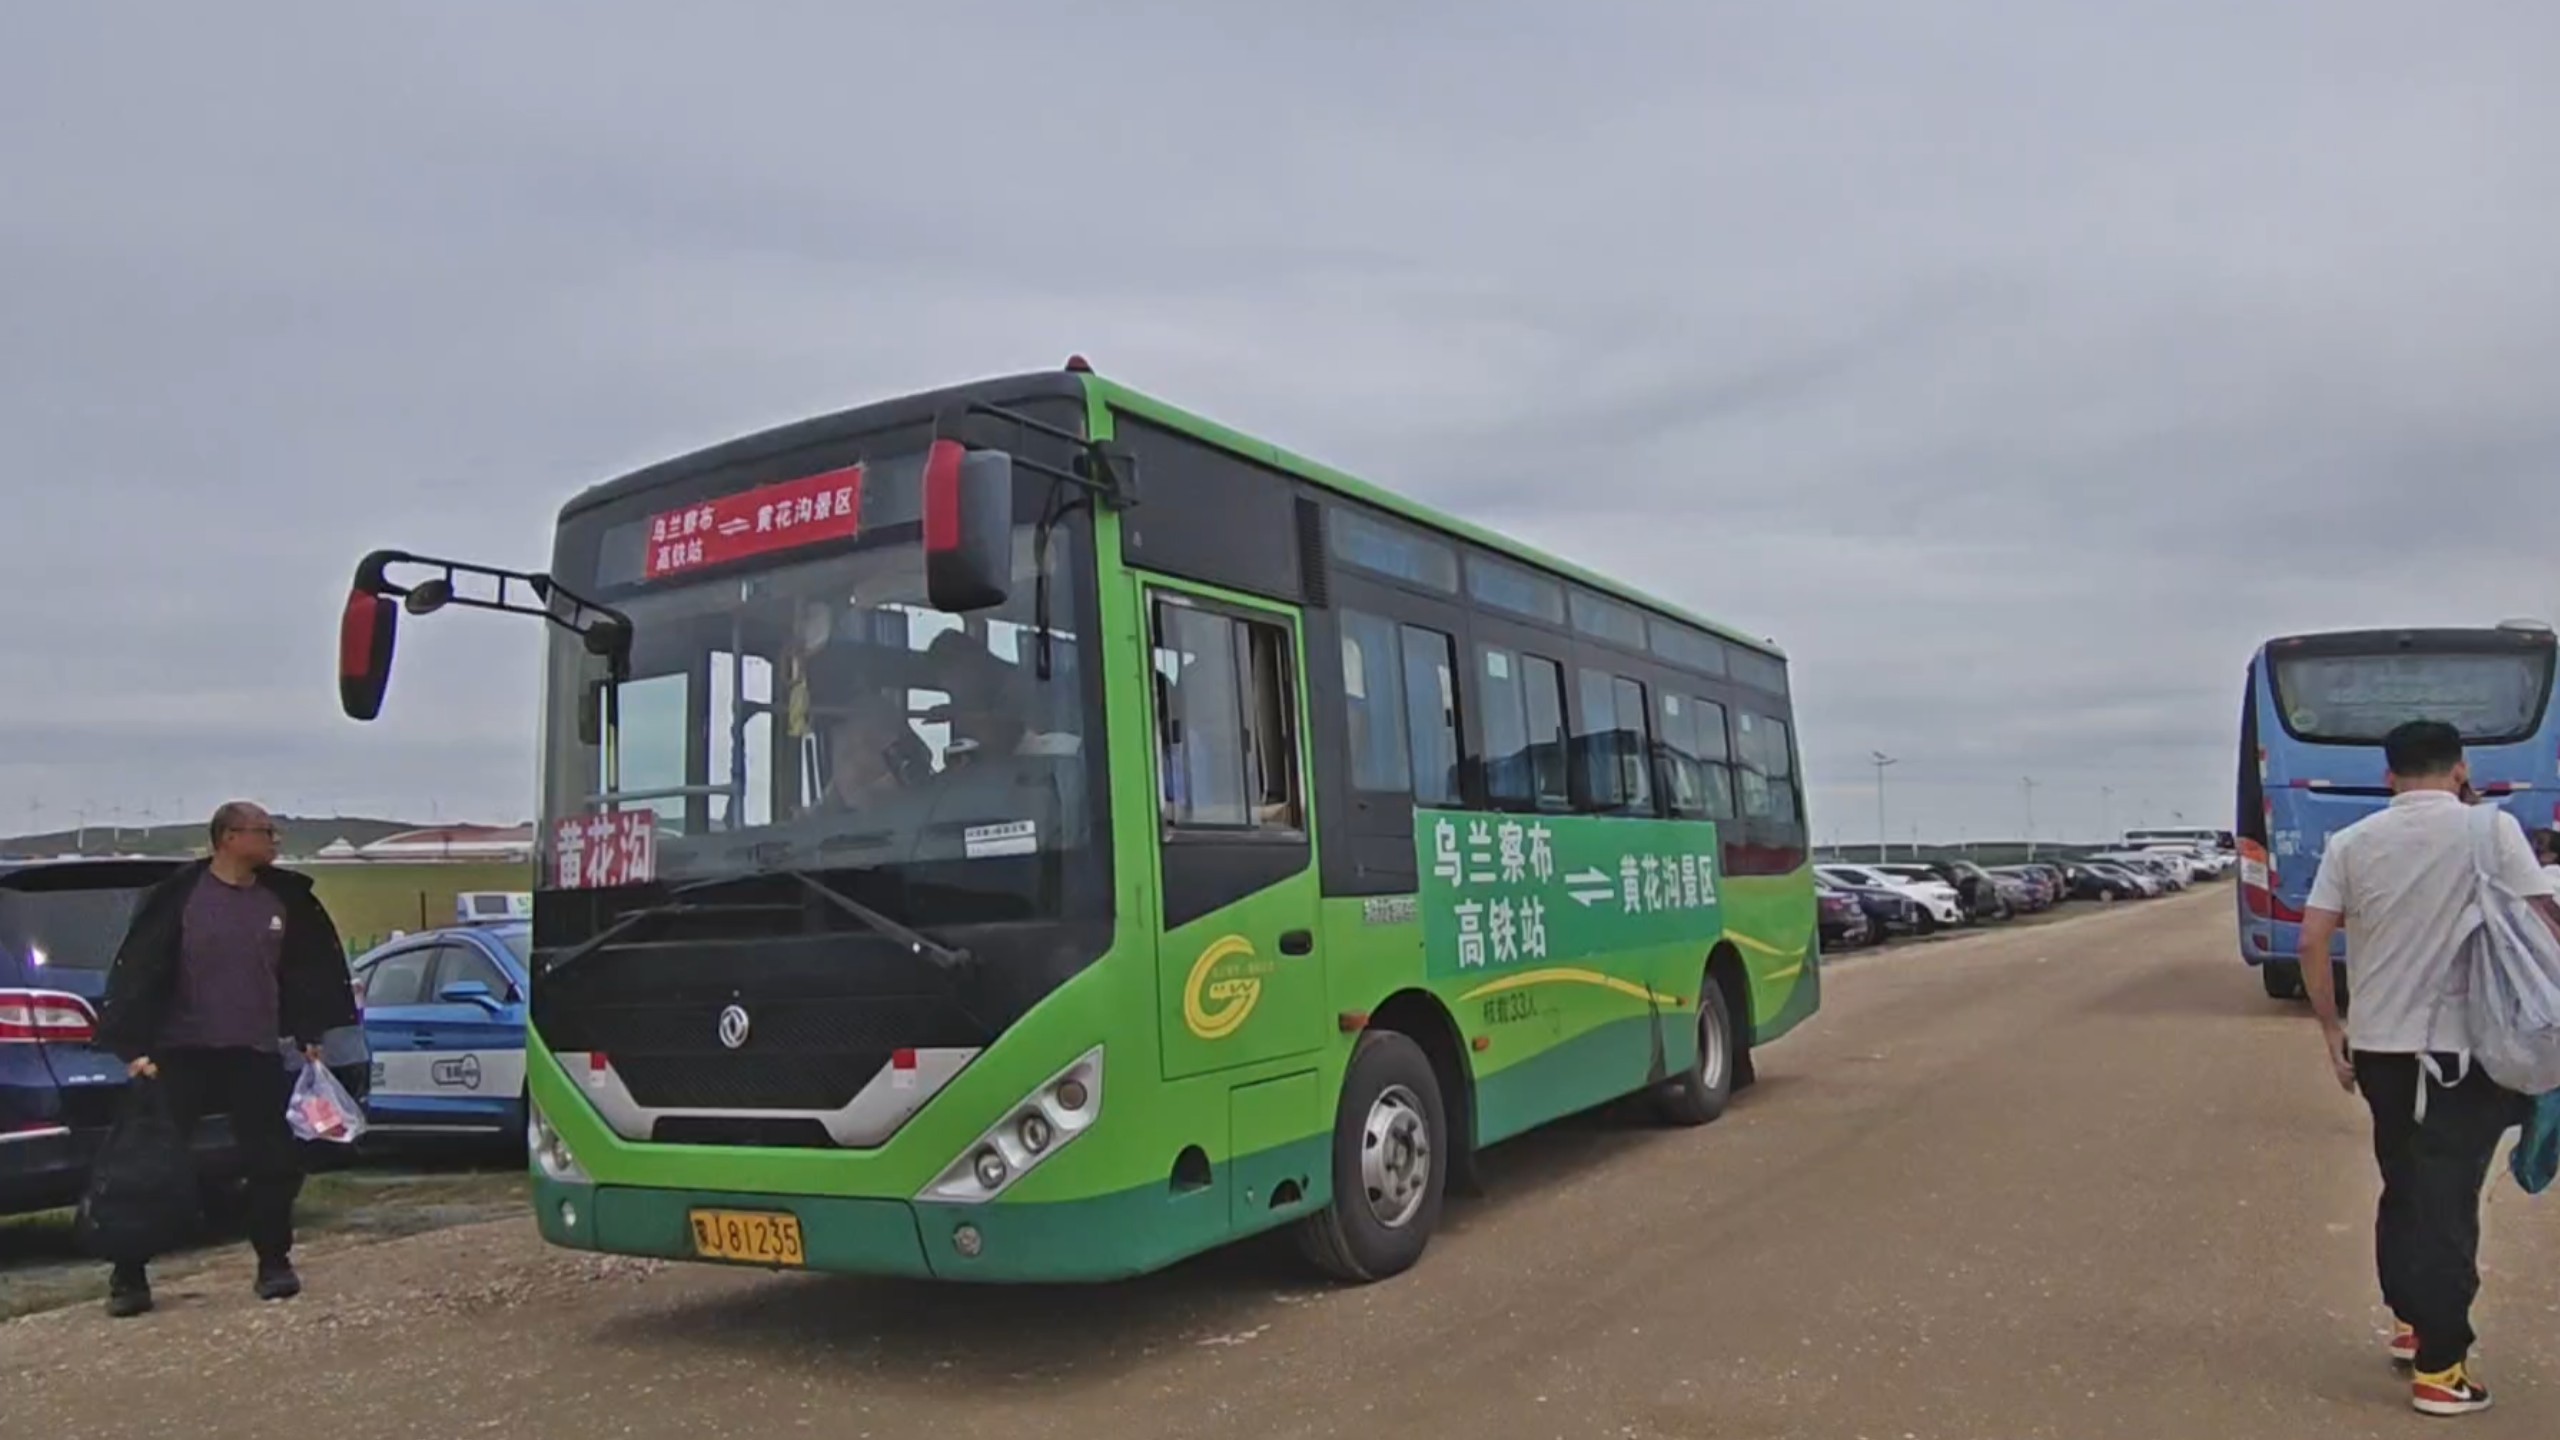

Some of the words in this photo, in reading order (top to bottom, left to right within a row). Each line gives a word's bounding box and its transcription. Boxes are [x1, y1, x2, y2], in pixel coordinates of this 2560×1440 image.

[756, 487, 853, 533] 黄花沟景区
[1434, 818, 1554, 888] 乌兰察布
[1620, 854, 1717, 914] 黄花沟景区
[1455, 895, 1547, 968] 高铁站
